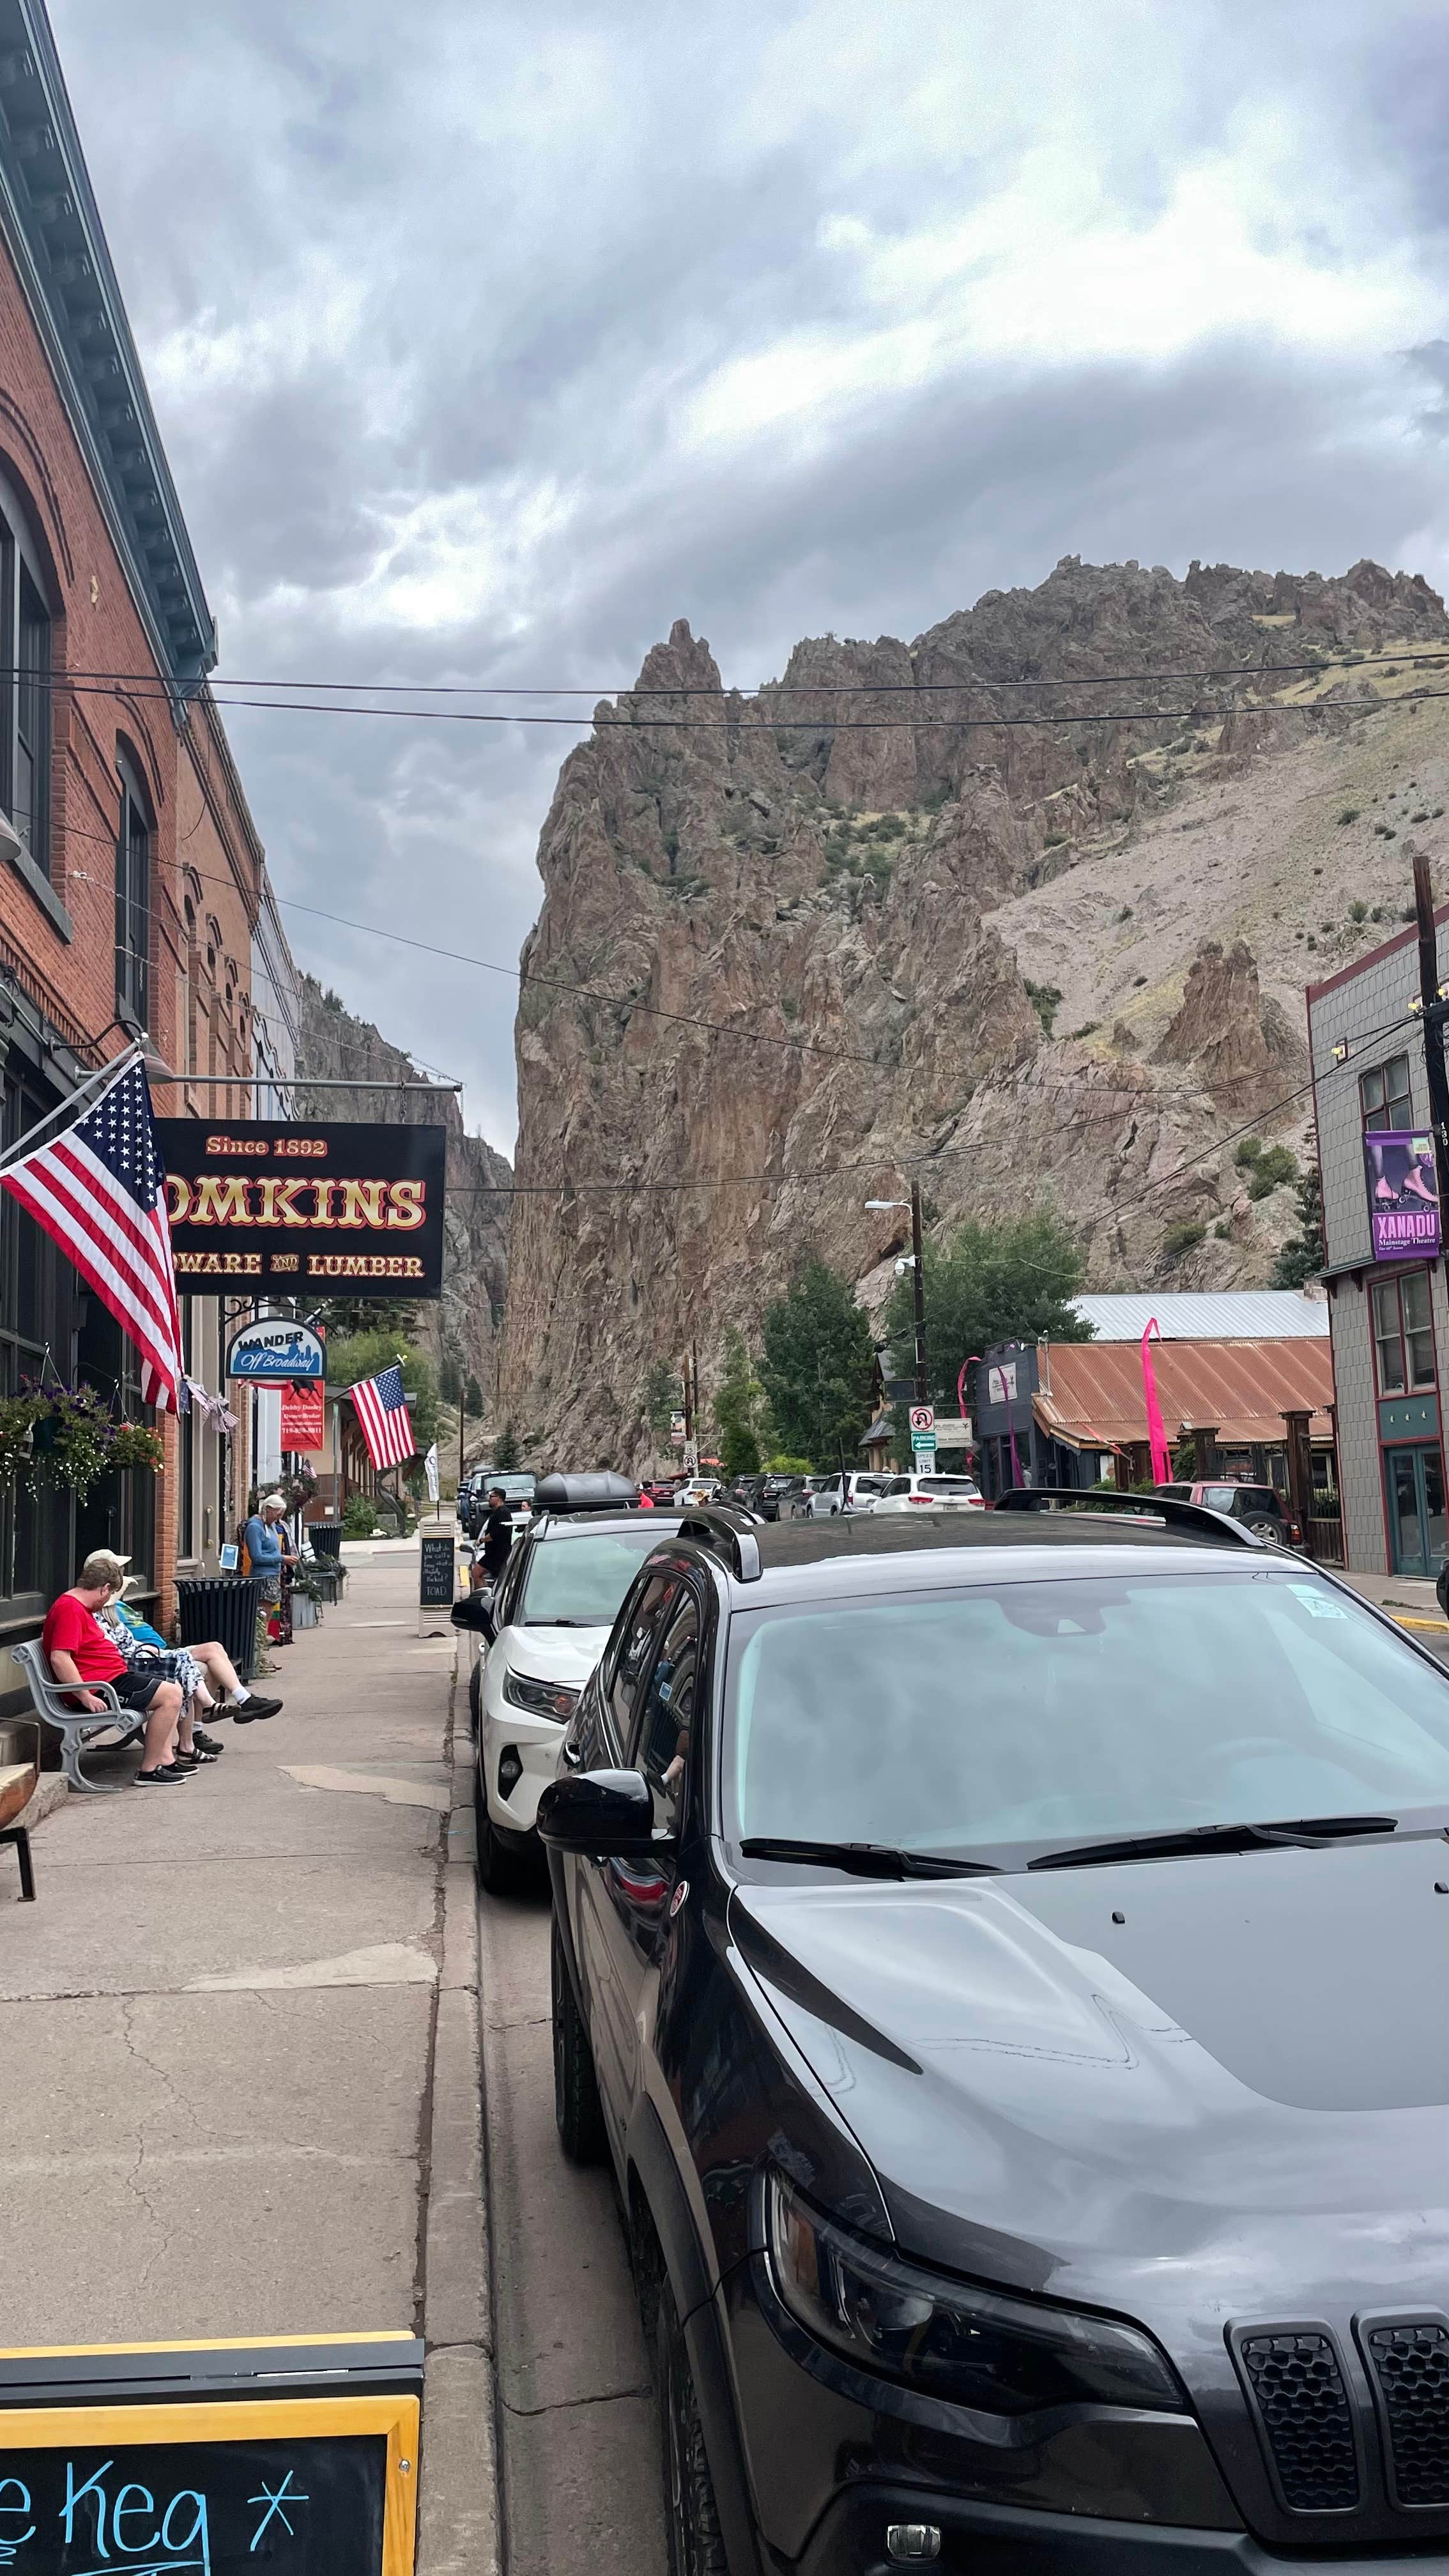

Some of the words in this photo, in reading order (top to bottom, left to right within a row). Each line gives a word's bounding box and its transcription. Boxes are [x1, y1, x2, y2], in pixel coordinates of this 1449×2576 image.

[206, 1137, 268, 1155] Since
[273, 1139, 327, 1156] 1892
[1377, 1214, 1436, 1239] XANADU
[1378, 1239, 1411, 1247] Mainstage
[271, 1255, 299, 1273] AND
[308, 1255, 425, 1278] LUMBER
[238, 1331, 304, 1351] WANDER
[240, 1352, 265, 1371] Off
[262, 1353, 314, 1372] Broadway
[919, 1464, 931, 1474] 15
[424, 1542, 442, 1553] What
[425, 1586, 447, 1597] TOAD
